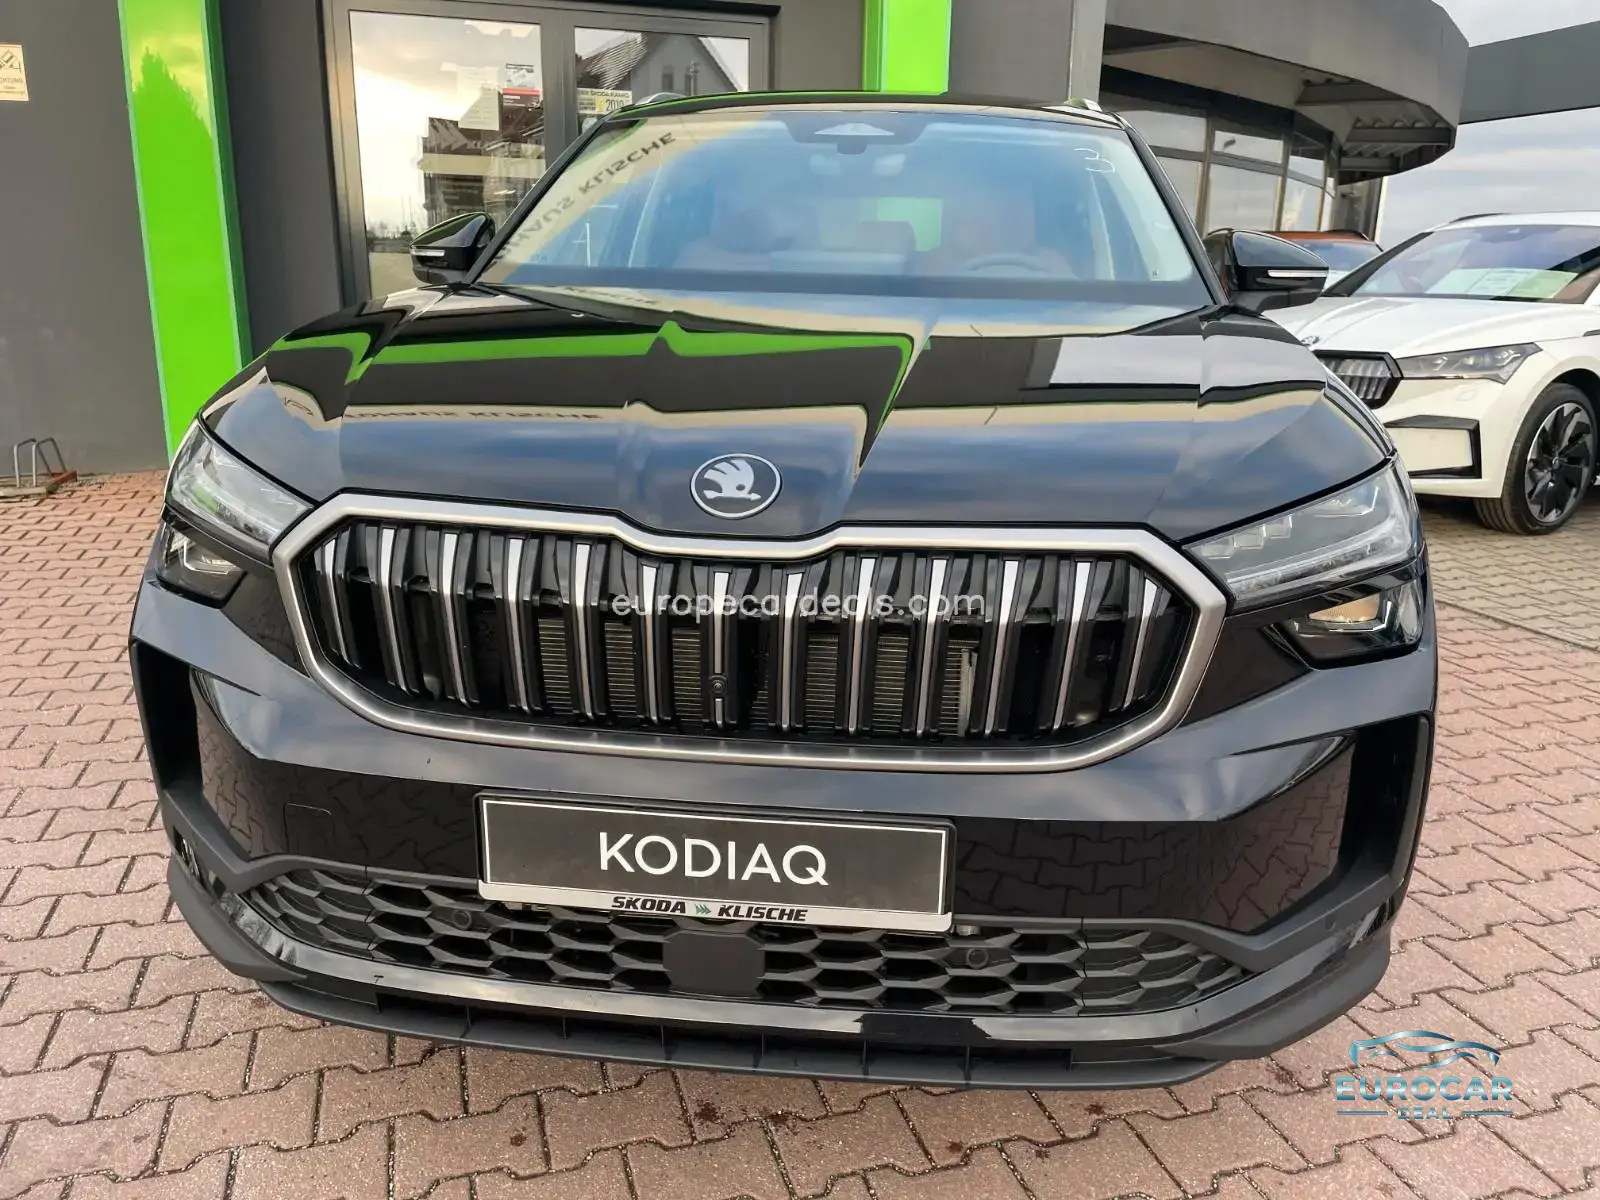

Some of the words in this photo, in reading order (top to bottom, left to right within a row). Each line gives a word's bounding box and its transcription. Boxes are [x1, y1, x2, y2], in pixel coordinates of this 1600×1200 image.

[599, 831, 829, 886] KODIAQ
[611, 896, 686, 914] SKODA
[717, 904, 809, 922] KLISCHE
